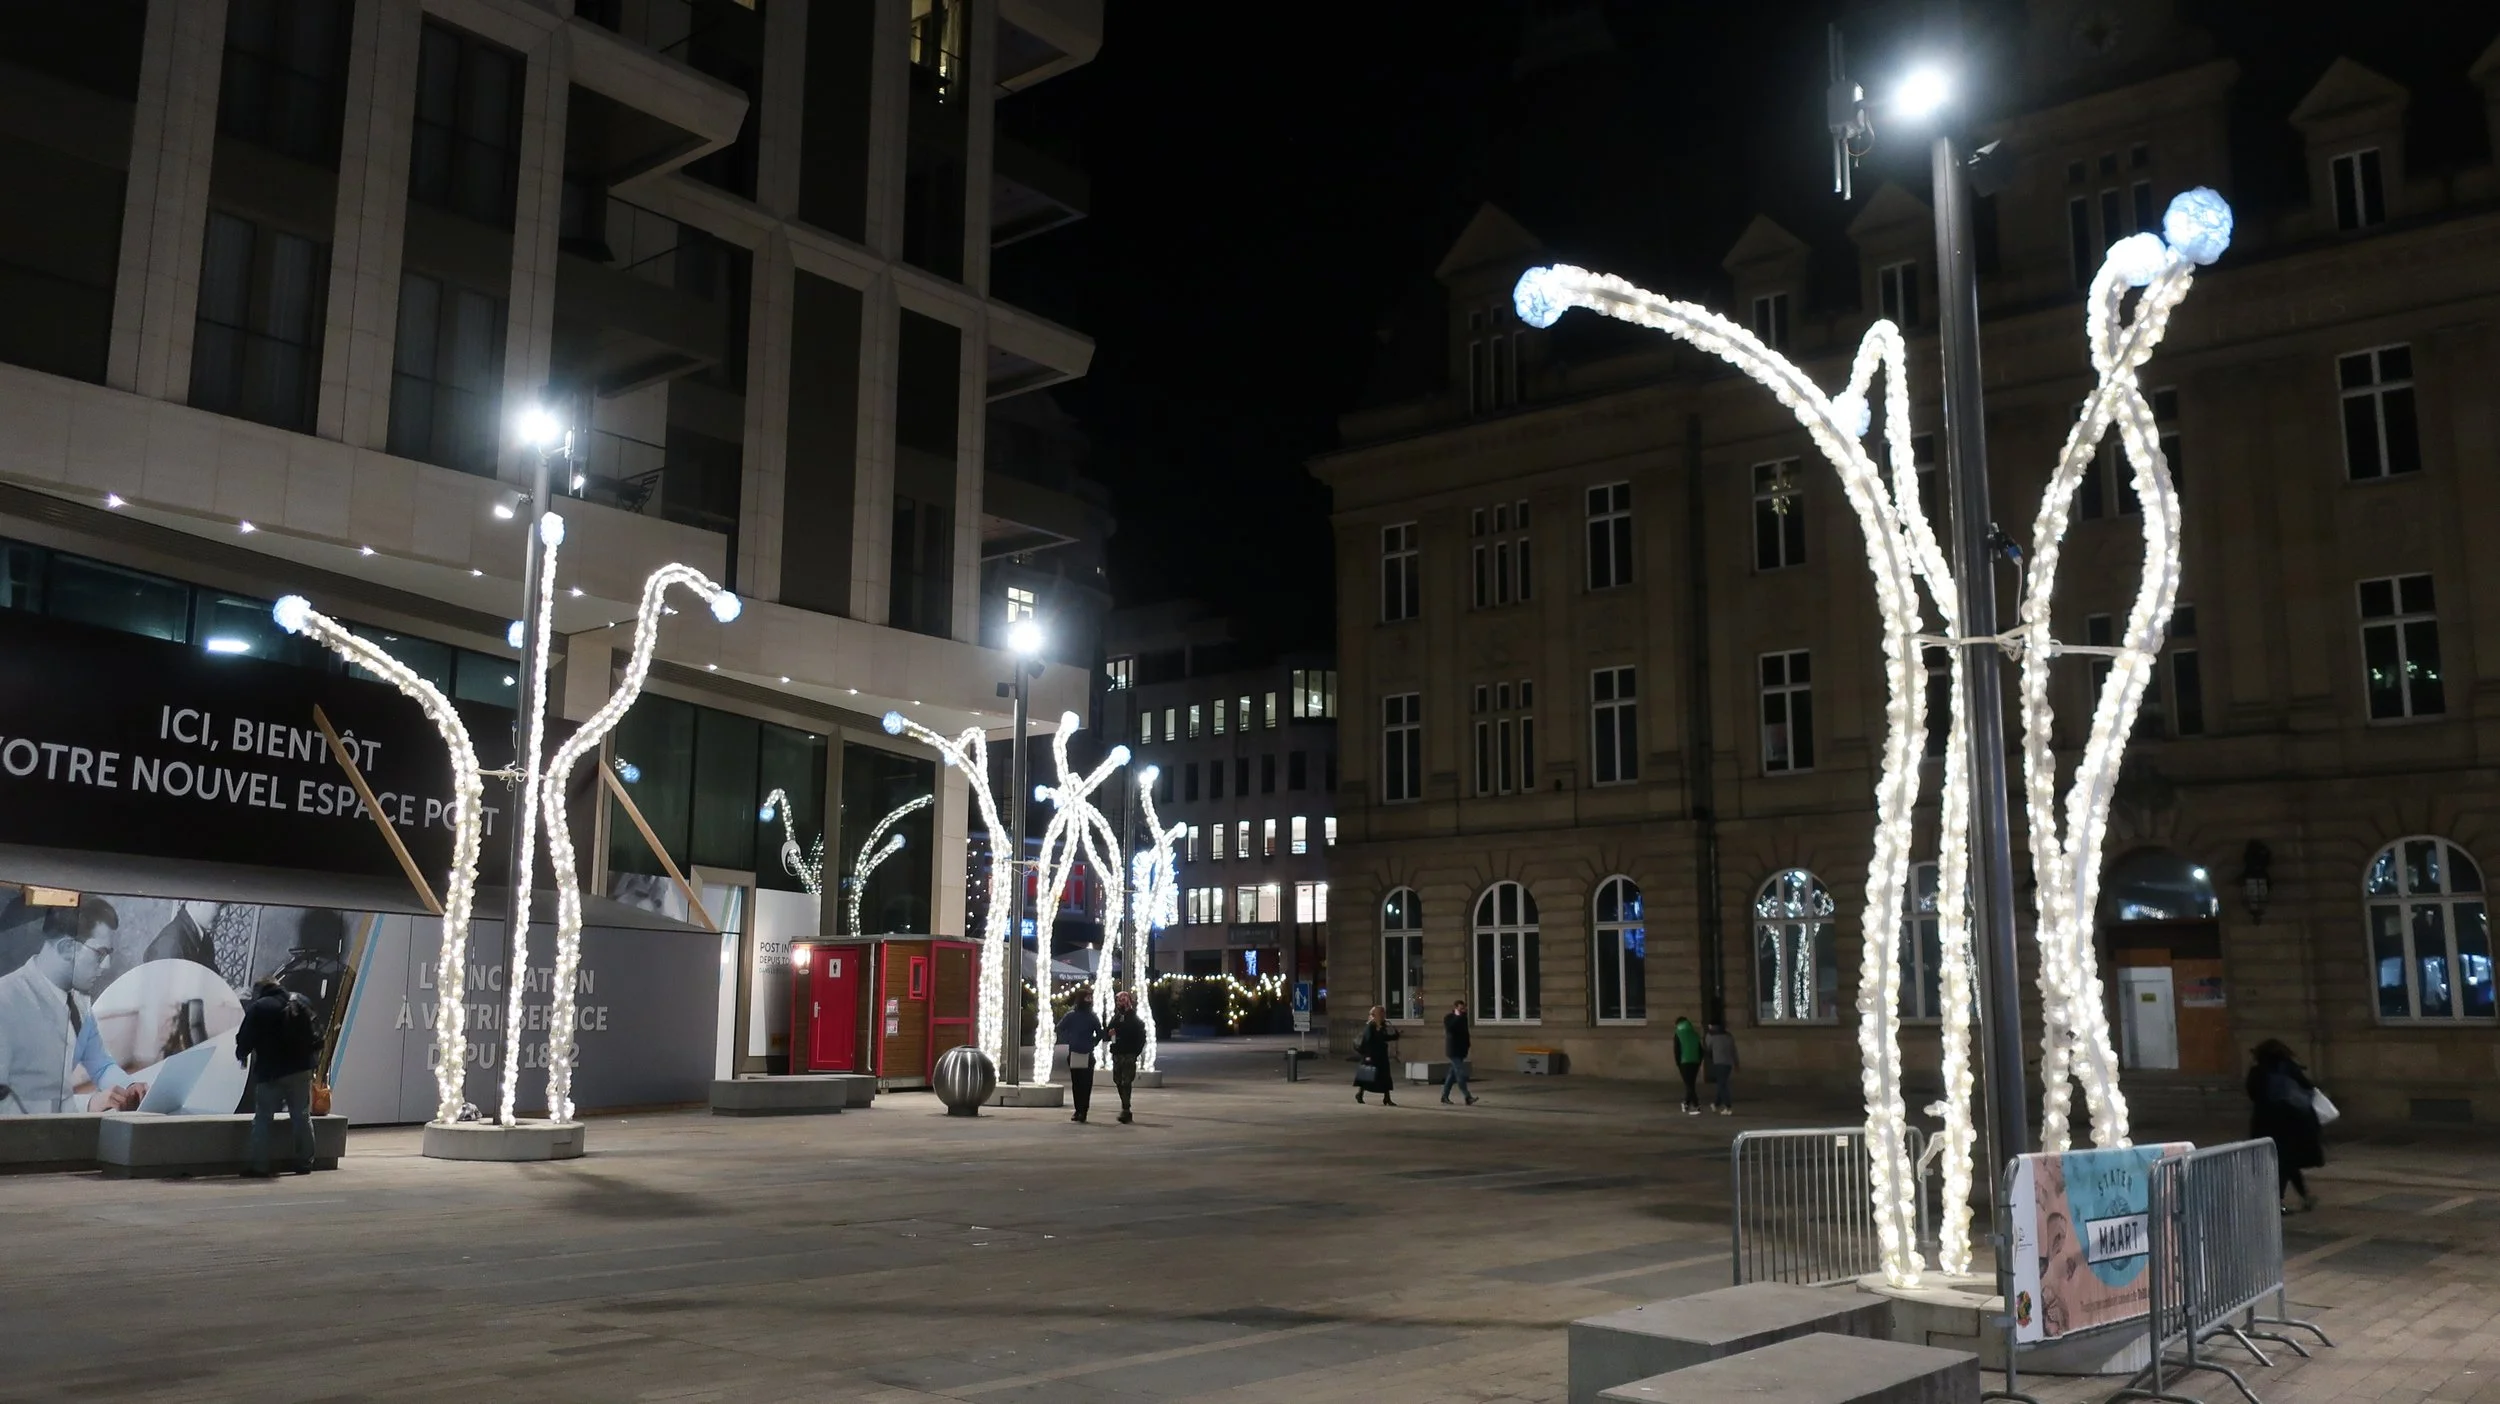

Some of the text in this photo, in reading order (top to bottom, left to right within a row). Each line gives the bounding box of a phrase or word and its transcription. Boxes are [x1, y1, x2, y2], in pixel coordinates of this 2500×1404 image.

[160, 705, 219, 751] ICI,
[0, 736, 500, 836] OTRE NOUVEL ESPACE POT
[760, 942, 780, 953] POST
[760, 955, 781, 965] DEPUIS
[519, 1004, 608, 1031] SERICE
[525, 1042, 580, 1069] 182
[2099, 1221, 2138, 1255] MAART
